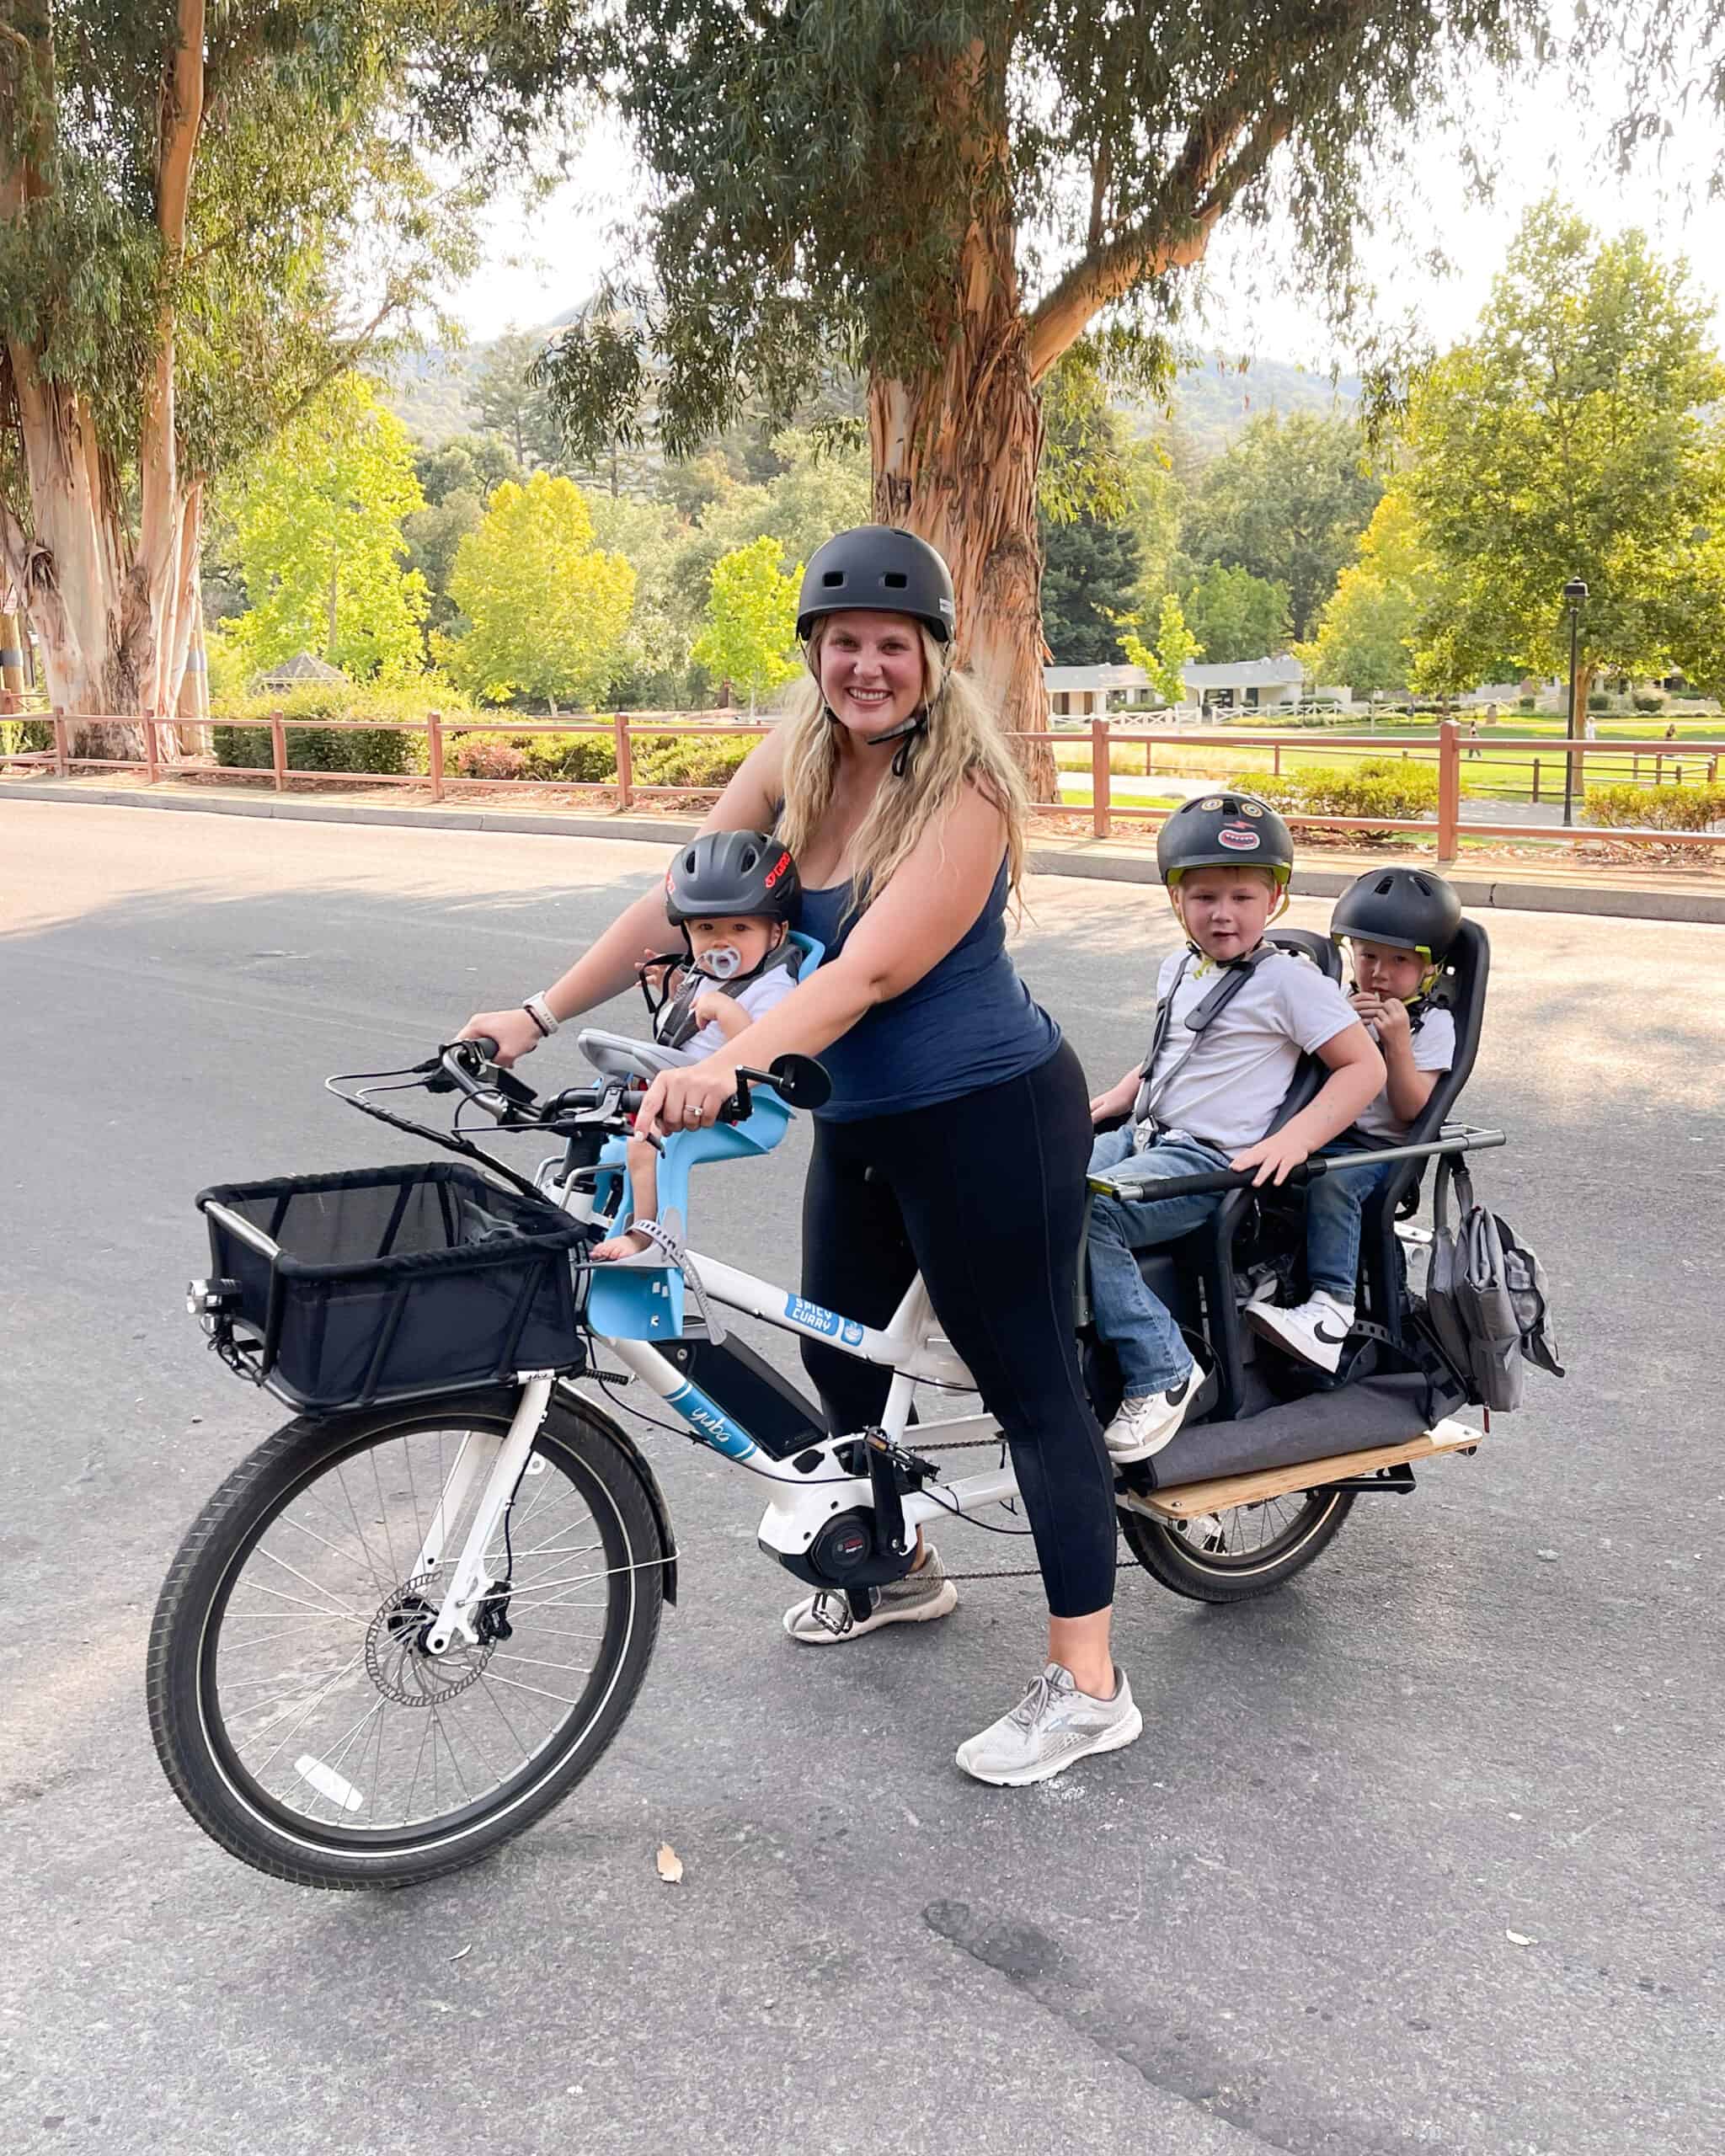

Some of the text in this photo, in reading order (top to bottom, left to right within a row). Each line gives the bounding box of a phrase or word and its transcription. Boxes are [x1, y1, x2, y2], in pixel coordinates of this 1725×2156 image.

[792, 1307, 830, 1331] CURRY
[795, 1297, 832, 1320] SPICY
[690, 1407, 732, 1443] yuba
